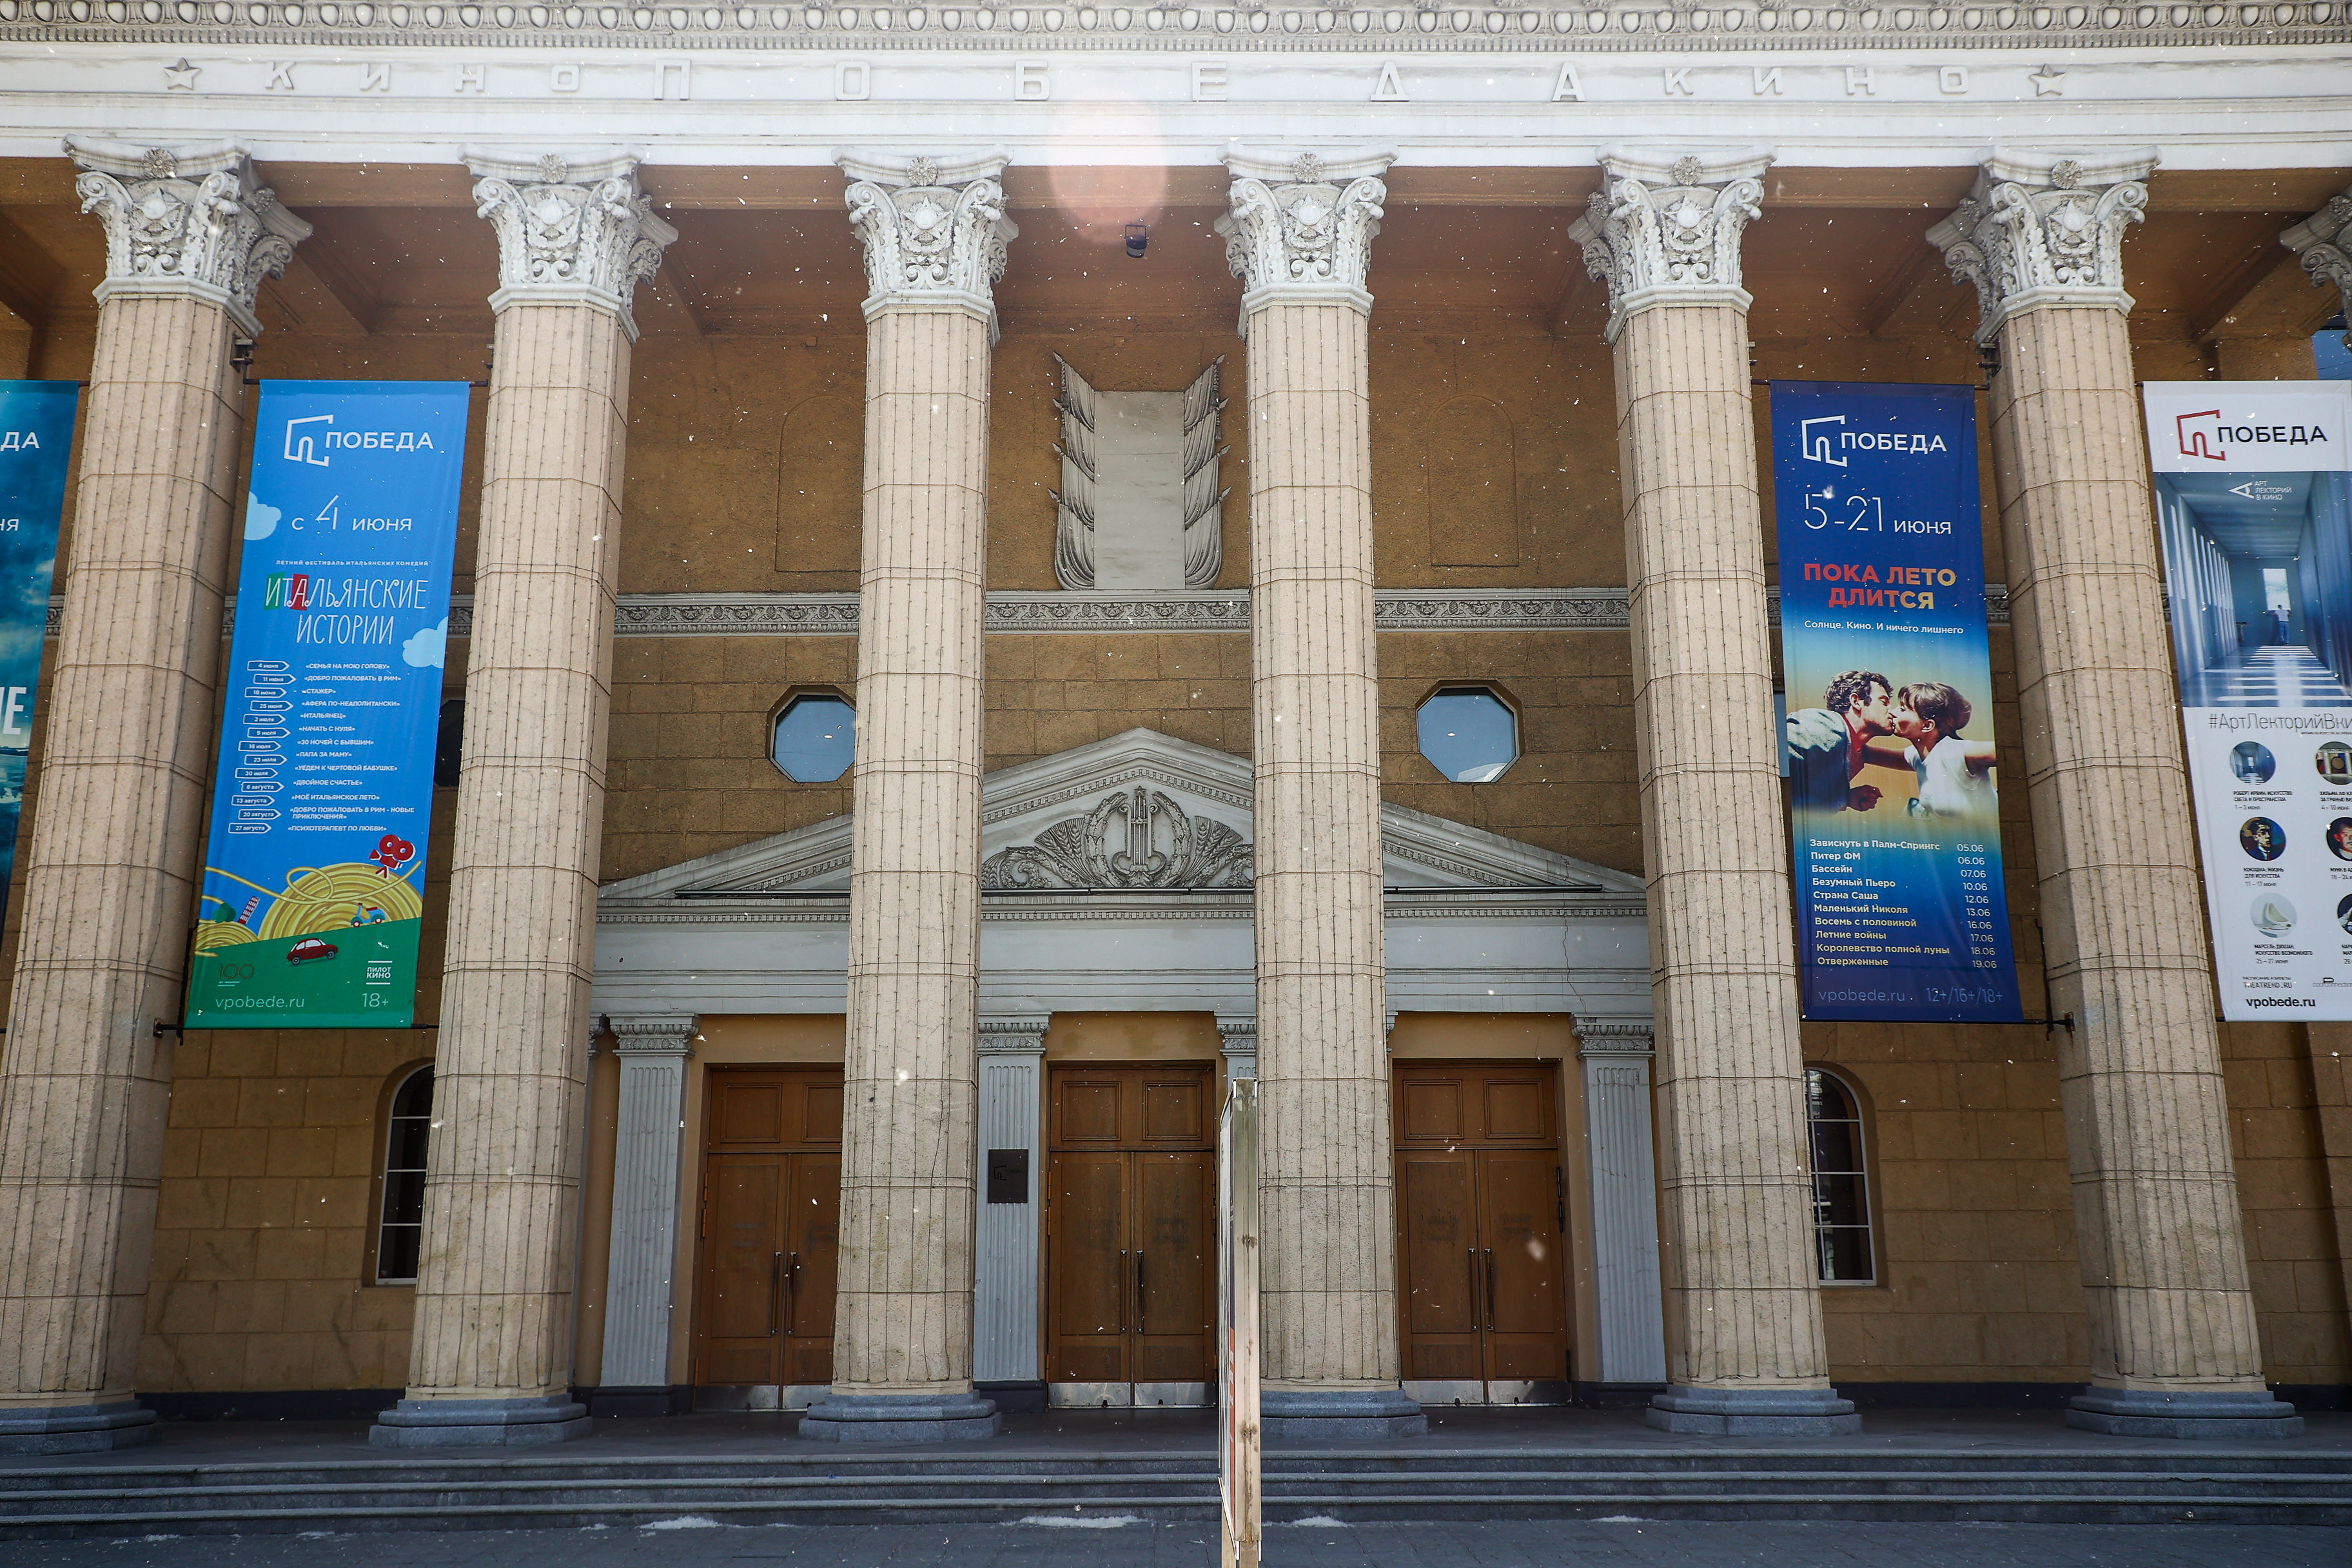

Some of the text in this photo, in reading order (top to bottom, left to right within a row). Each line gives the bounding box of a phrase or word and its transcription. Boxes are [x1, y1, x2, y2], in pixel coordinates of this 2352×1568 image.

[264, 61, 580, 92] КИНО
[1663, 65, 1969, 97] КИНО
[2218, 426, 2328, 445] ПОБЕДА
[325, 431, 434, 452] ПОБЕДА
[1841, 432, 1947, 454] ПОБЕДА
[315, 495, 339, 531] 4
[1804, 564, 1956, 586] ПОКА ЛЕТО
[265, 578, 429, 609] ИТАЛЬЯНСКИЕ
[1828, 587, 1934, 609] ДЛИТСЯ
[296, 614, 395, 645] ИСТОРИИ
[1804, 620, 1844, 631] Солнце.
[1847, 622, 1874, 631] Кино.
[1810, 839, 1861, 848] Зависнуть
[1871, 839, 1939, 850] Палм-Спрингс
[1957, 843, 1983, 852] 05.06
[1810, 852, 1841, 861] Питер
[1957, 856, 1984, 865] 06.06
[1960, 869, 1986, 877] 07.06
[1812, 877, 1896, 888] Безумный Пьеро
[1963, 882, 1987, 890] 10.06
[1813, 890, 1878, 900] Страна Саша
[1965, 895, 1988, 903] 12.06
[1872, 904, 1908, 913] Николя
[1966, 908, 1990, 916] 13.06
[1967, 921, 1992, 929] 16.06
[1854, 930, 1886, 939] войны
[1970, 934, 1993, 942] 17.06
[1816, 943, 1882, 952] Королевство
[1970, 946, 1995, 955] 18.06
[1817, 957, 1888, 966] Отверженные
[218, 964, 254, 979] 100
[362, 992, 389, 1008] 18+
[1818, 988, 1905, 1002] vpobede.ru
[1926, 986, 2003, 1004] 12+/16+/18+
[215, 995, 304, 1010] vpobede.ru
[2246, 996, 2316, 1009] vpobede.ru
